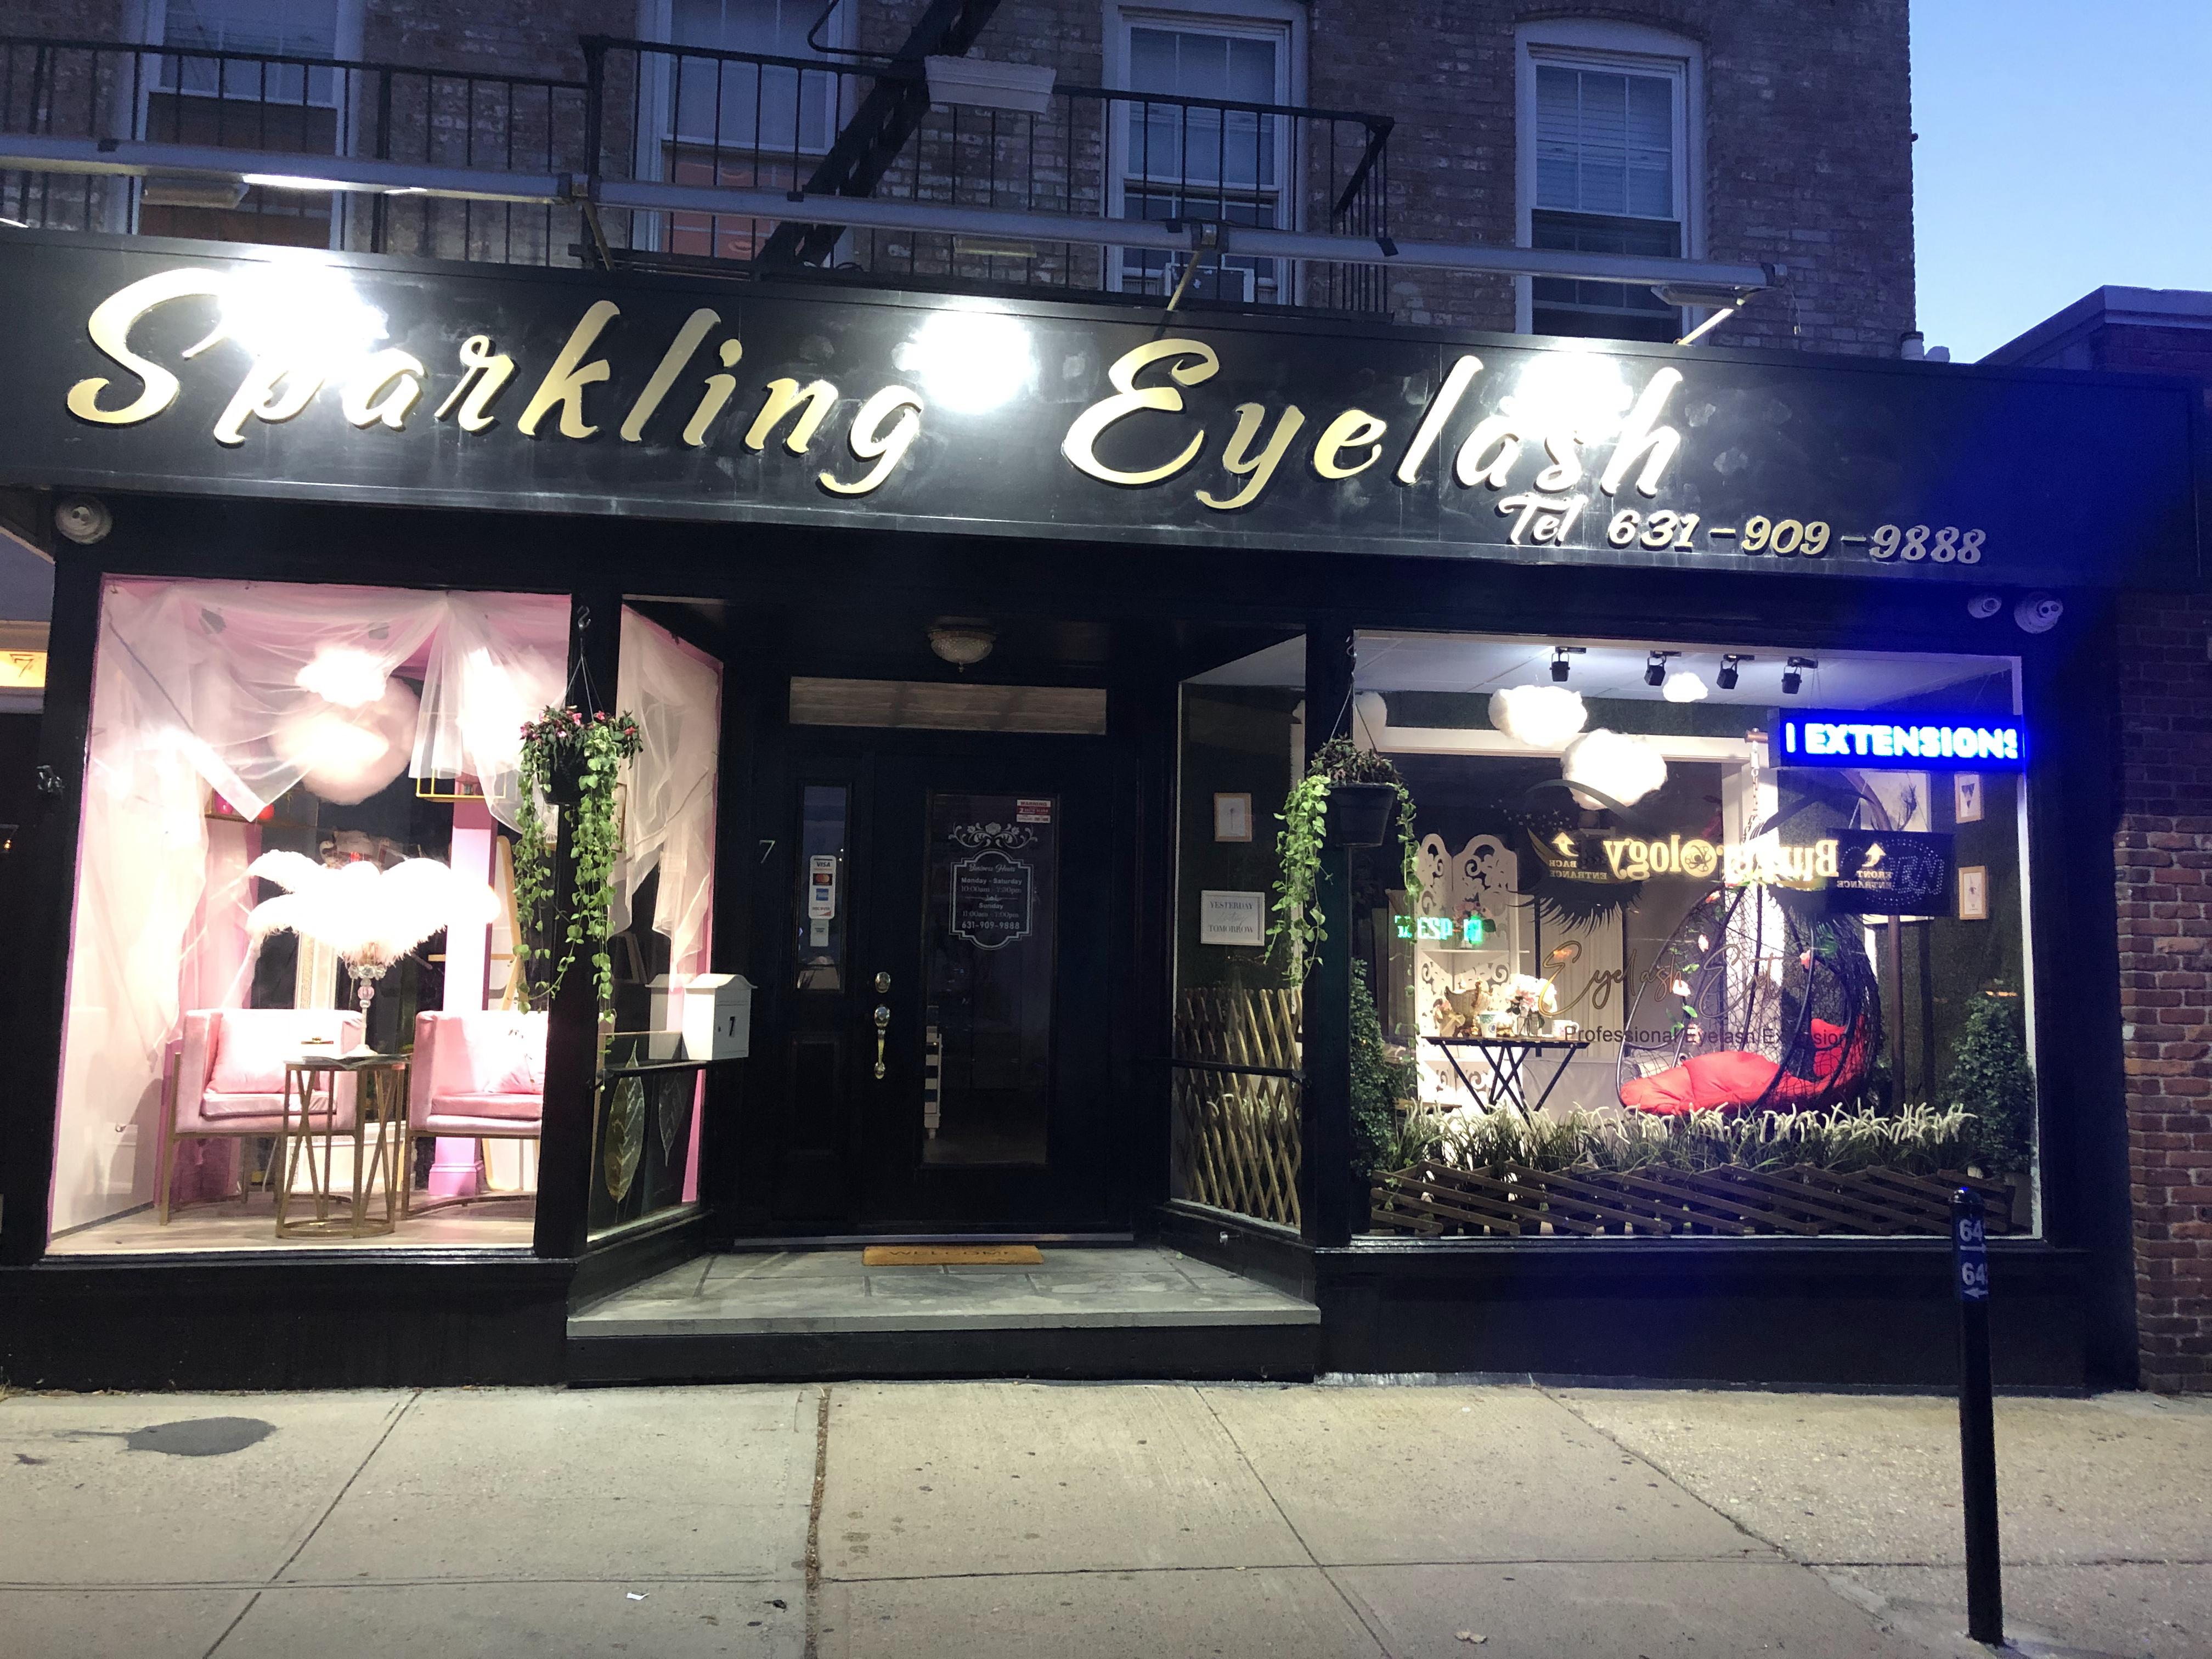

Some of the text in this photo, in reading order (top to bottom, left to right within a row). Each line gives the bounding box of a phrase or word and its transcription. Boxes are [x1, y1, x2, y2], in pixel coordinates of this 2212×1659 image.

[67, 267, 1683, 510] Sparkling Eyelash
[1499, 493, 1588, 545] Tel
[759, 840, 775, 864] 7
[1210, 901, 1253, 910] YESTERDAY
[962, 921, 1020, 929] 631-909-9888
[1209, 925, 1254, 933] TOMORROW
[1538, 940, 1683, 1016] Eyelash
[1565, 1026, 1677, 1043] Professional
[1959, 1219, 1983, 1242] 64
[1961, 1262, 1985, 1285] 64
